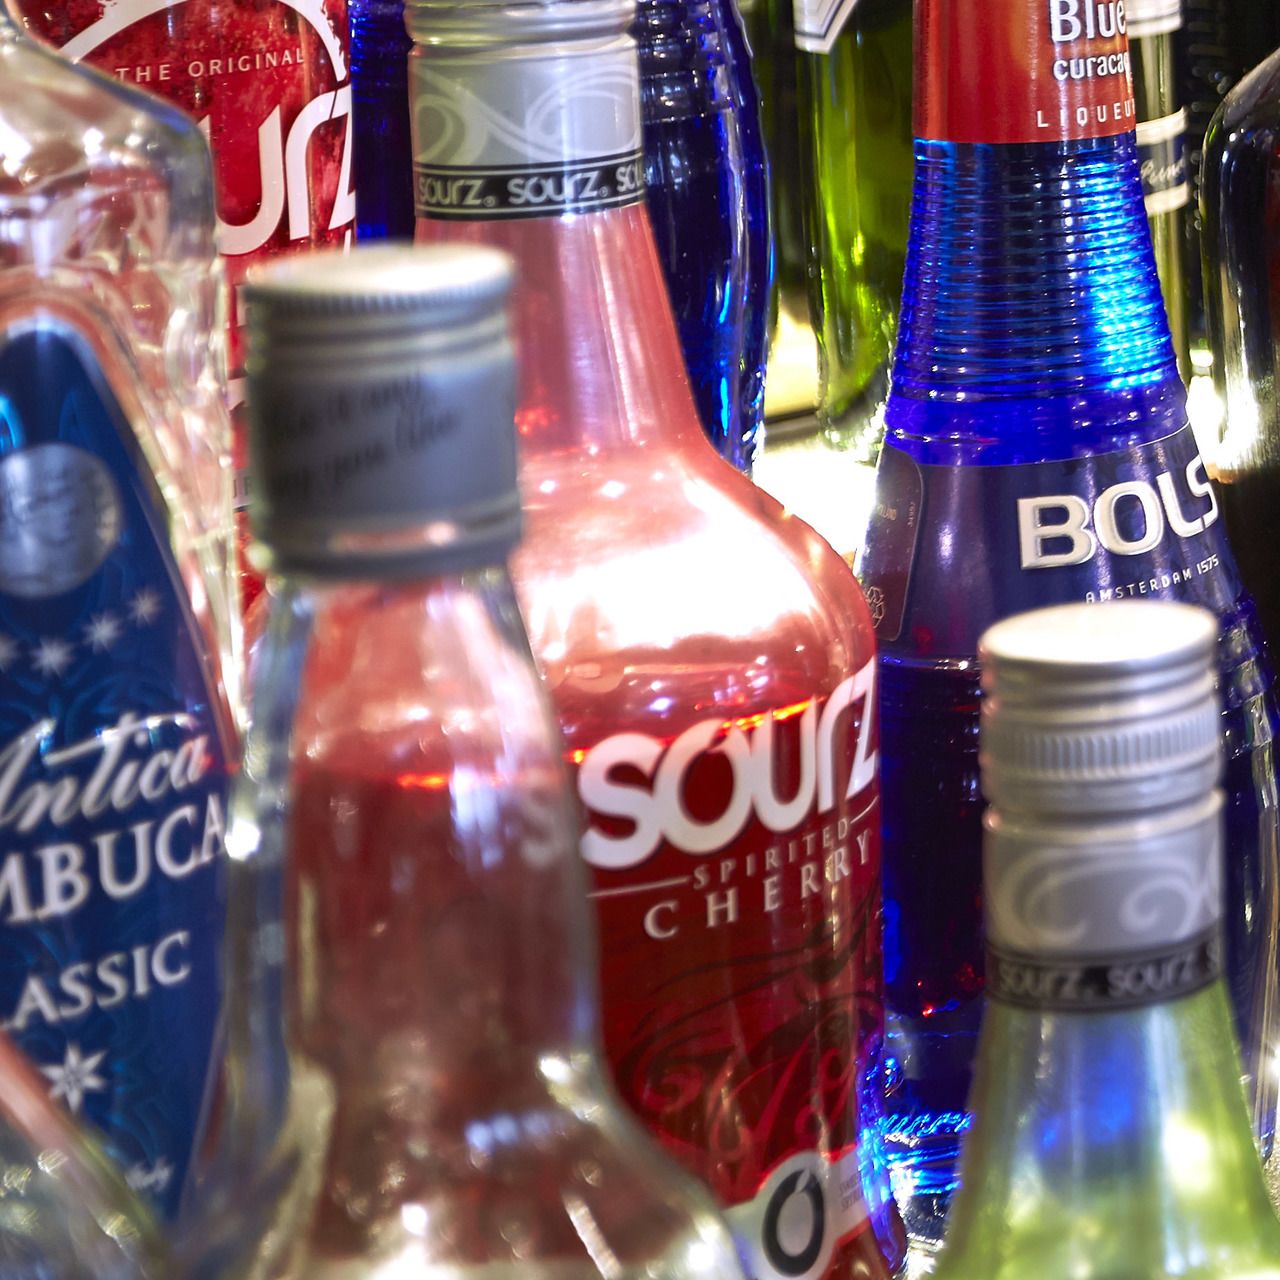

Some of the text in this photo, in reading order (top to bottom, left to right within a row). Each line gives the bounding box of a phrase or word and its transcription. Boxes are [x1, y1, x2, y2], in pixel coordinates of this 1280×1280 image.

[116, 48, 306, 82] THE ORIGINAL
[1037, 96, 1136, 129] LIQUEU
[507, 170, 600, 205] sourz
[1017, 454, 1219, 570] BOLS
[1085, 554, 1219, 604] AMSTERDAM 1575
[578, 656, 879, 869] sourz
[643, 829, 870, 940] CHERRY
[693, 818, 849, 890] SPIRITED
[10, 930, 193, 1030] ASSIC
